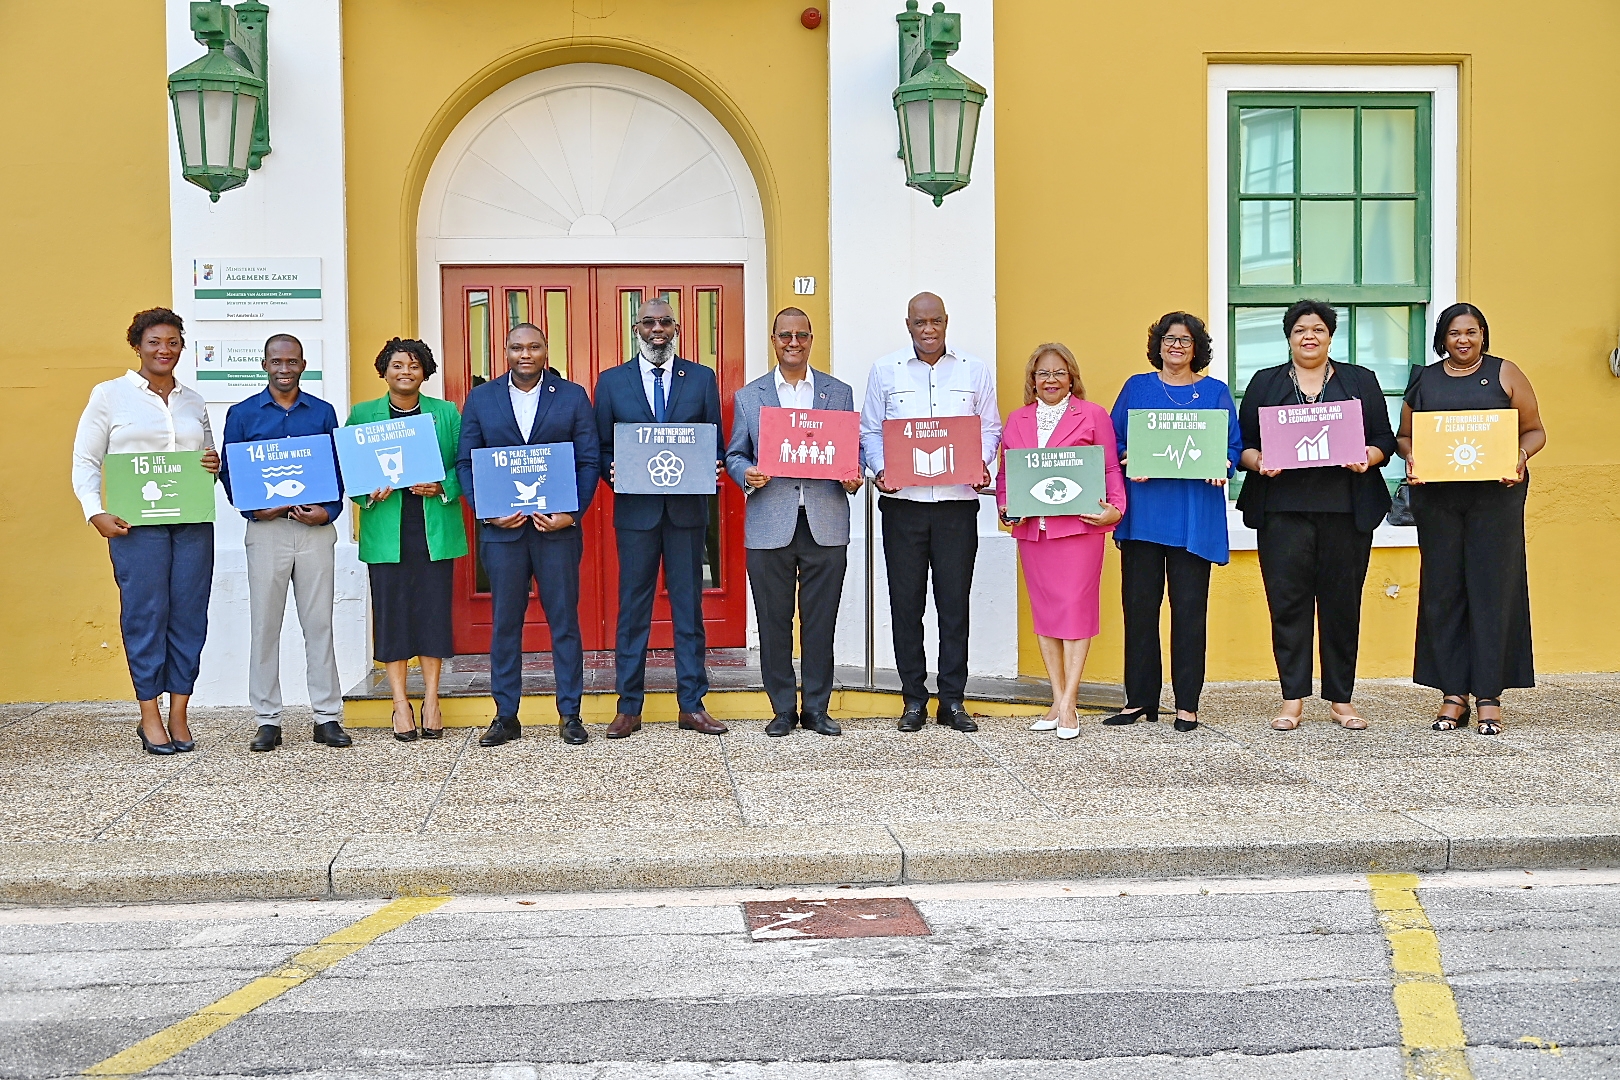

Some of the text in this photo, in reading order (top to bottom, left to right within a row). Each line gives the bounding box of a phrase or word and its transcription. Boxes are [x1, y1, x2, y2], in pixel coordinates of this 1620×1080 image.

[799, 279, 810, 293] 17
[1288, 405, 1341, 416] DECENT WORK AND
[789, 412, 796, 428] 1
[1147, 412, 1156, 430] 3
[1159, 413, 1198, 421] GOOD HEALTH
[1278, 410, 1287, 424] 8
[1289, 415, 1317, 424] ECONOMIC
[1446, 414, 1499, 423] AFFORDABLE AND
[366, 421, 405, 434] CLEAN WATER
[799, 421, 823, 429] POVERTY
[916, 421, 940, 430] QUALITY
[1158, 422, 1206, 430] AND WELL-BEING
[1434, 415, 1443, 432] 7
[1446, 423, 1490, 432] CLEAN ENERGY
[636, 426, 652, 443] 17
[904, 422, 912, 438] 4
[916, 429, 948, 438] EDUCATION
[355, 428, 365, 445] 6
[368, 428, 416, 444] AND SANITATION
[654, 436, 695, 444] FOR THE GOALS
[246, 444, 265, 462] 14
[266, 443, 279, 452] LIFE
[267, 449, 311, 460] BELOW WATER
[492, 451, 507, 467] 16
[509, 448, 551, 459] PEACE, JUSTICE
[1041, 452, 1057, 460] CLEAN
[131, 456, 150, 474] 15
[153, 456, 165, 464] LIFE
[510, 456, 545, 466] AND STRONG
[1025, 453, 1039, 468] 13
[1054, 459, 1084, 467] SANITATION
[153, 464, 181, 473] ON LAND
[510, 464, 548, 474] INSTITUTIONS
